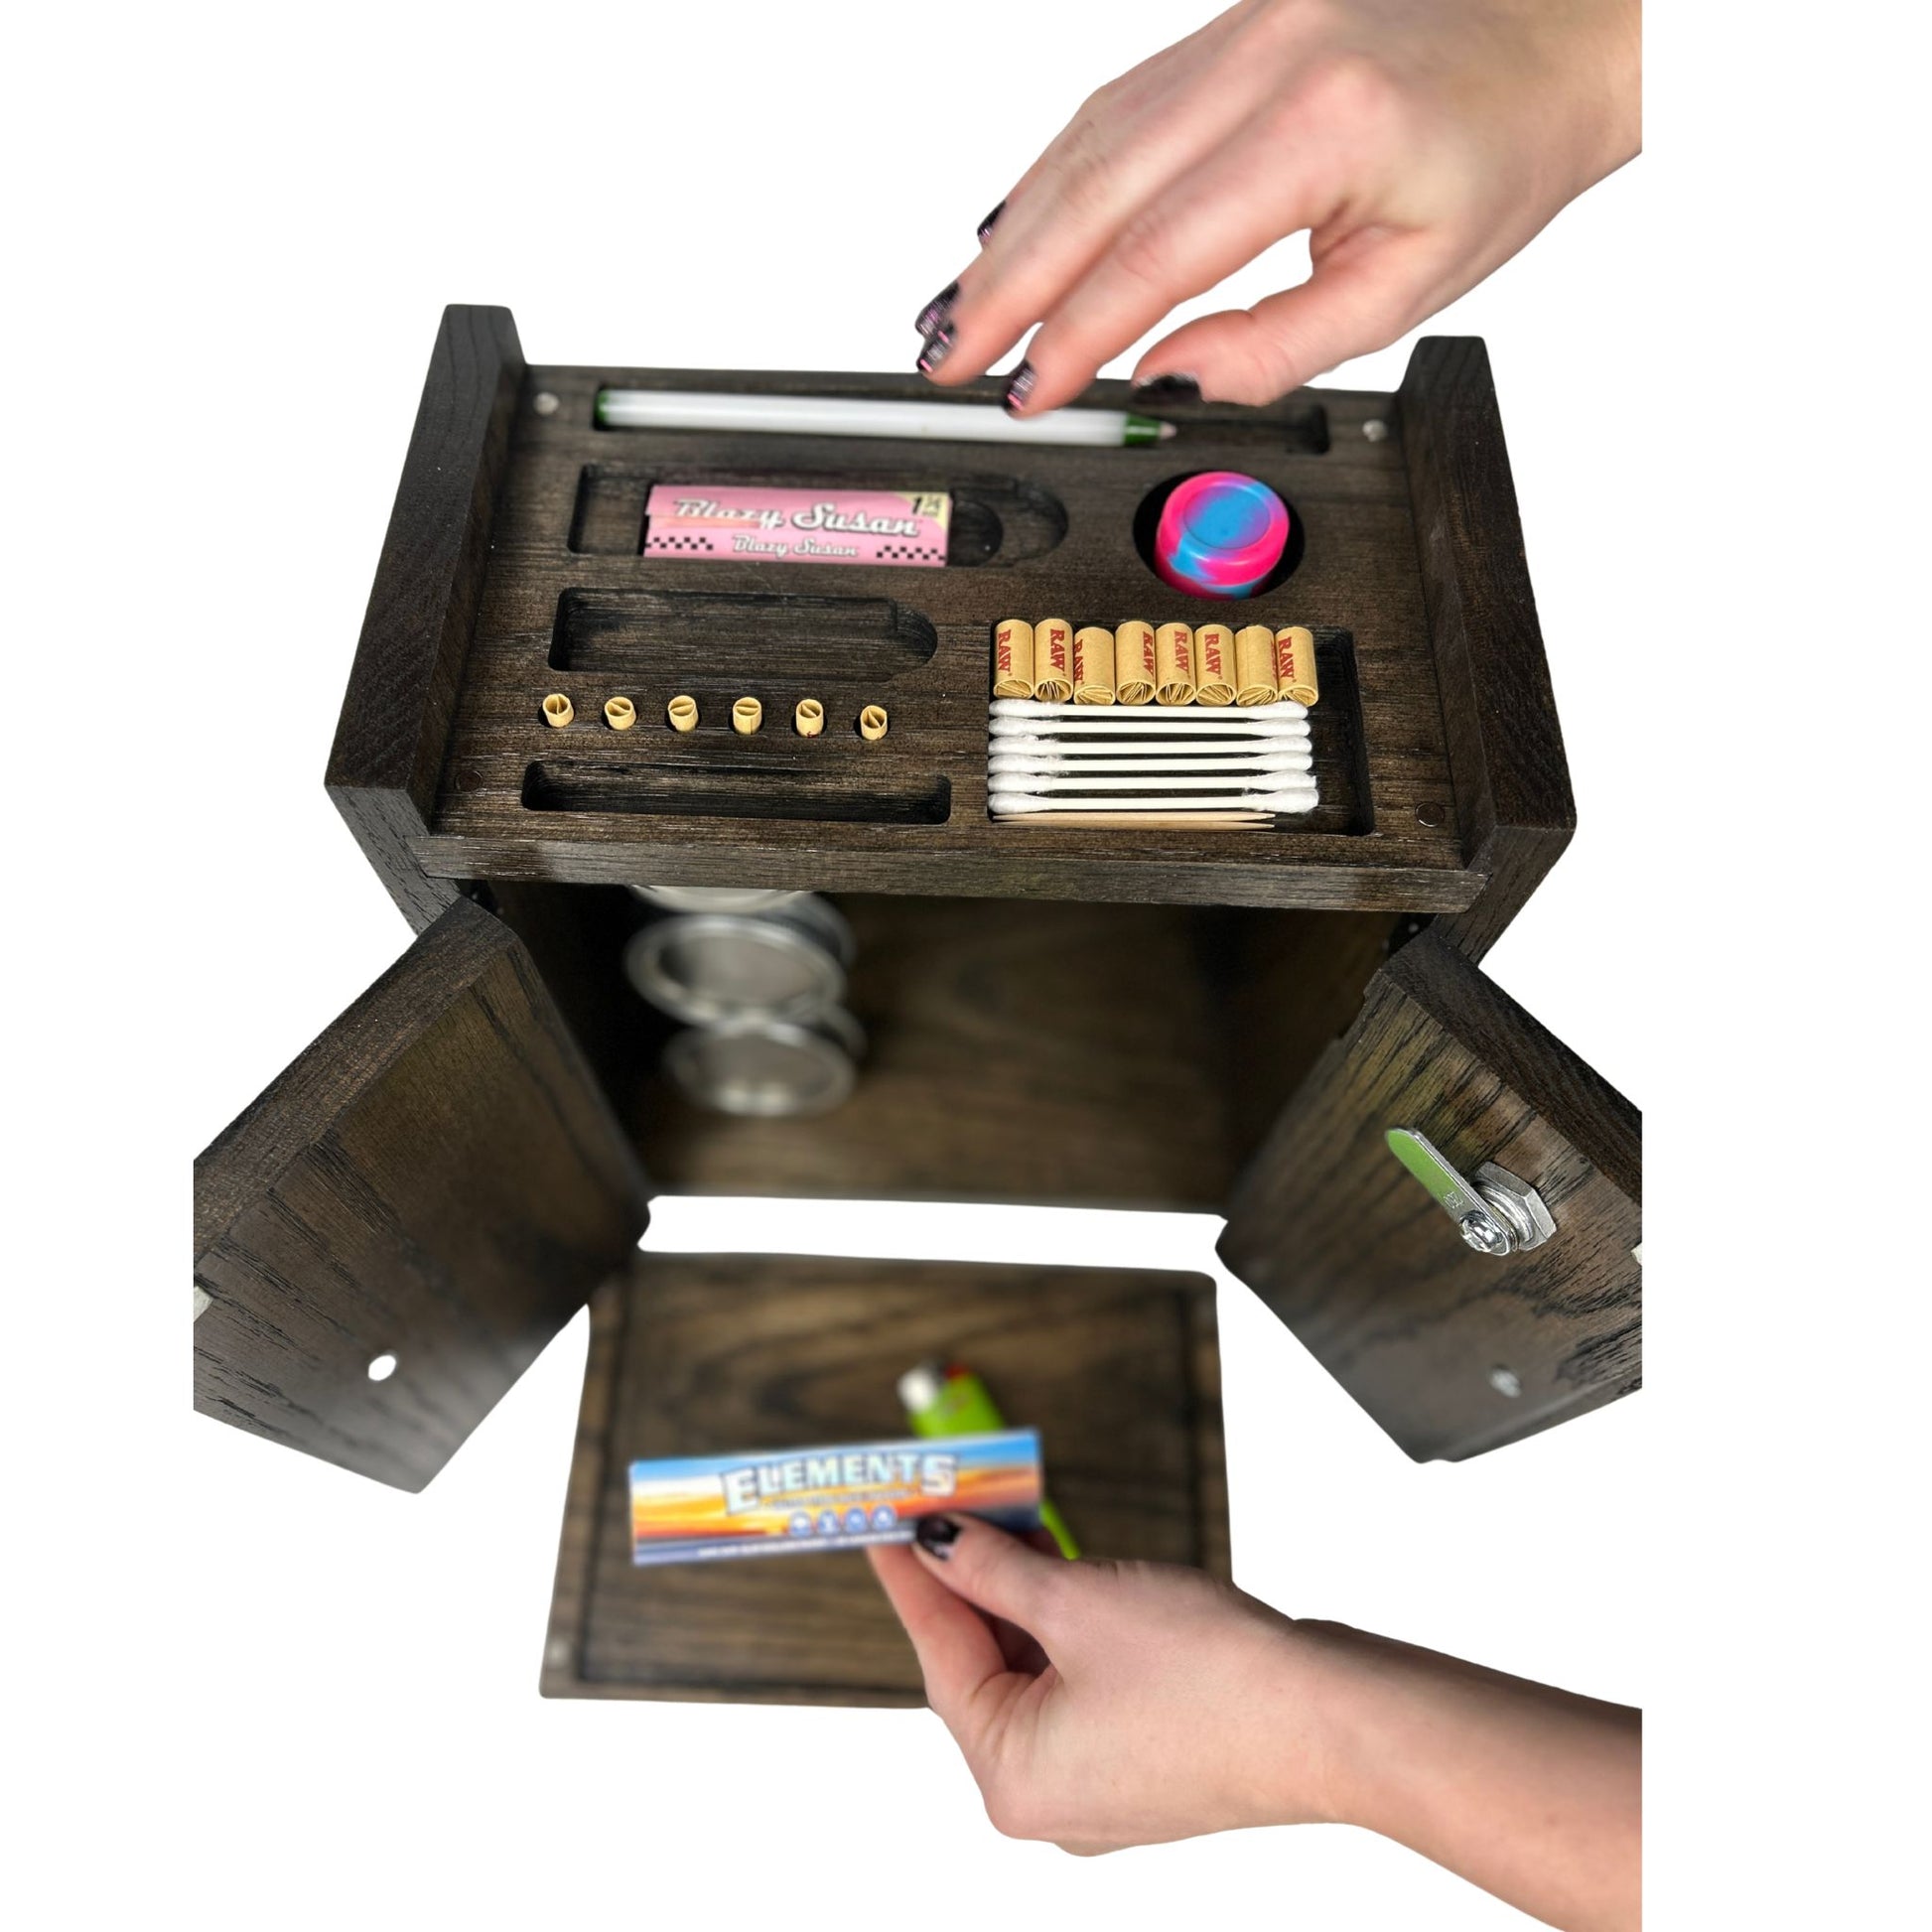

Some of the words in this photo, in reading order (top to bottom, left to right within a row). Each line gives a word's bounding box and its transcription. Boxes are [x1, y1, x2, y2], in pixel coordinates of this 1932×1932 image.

[673, 498, 785, 529] Blazy
[792, 502, 919, 537] Susan
[733, 534, 787, 559] Blazy
[793, 537, 858, 557] Susan
[998, 628, 1012, 672] RAW
[1049, 628, 1065, 672] RAW
[1143, 630, 1155, 677] RAW
[1174, 630, 1189, 672] RAW
[1204, 633, 1221, 675] RAW
[1278, 636, 1295, 679] RAW
[721, 1451, 960, 1516] ELEMENTS
